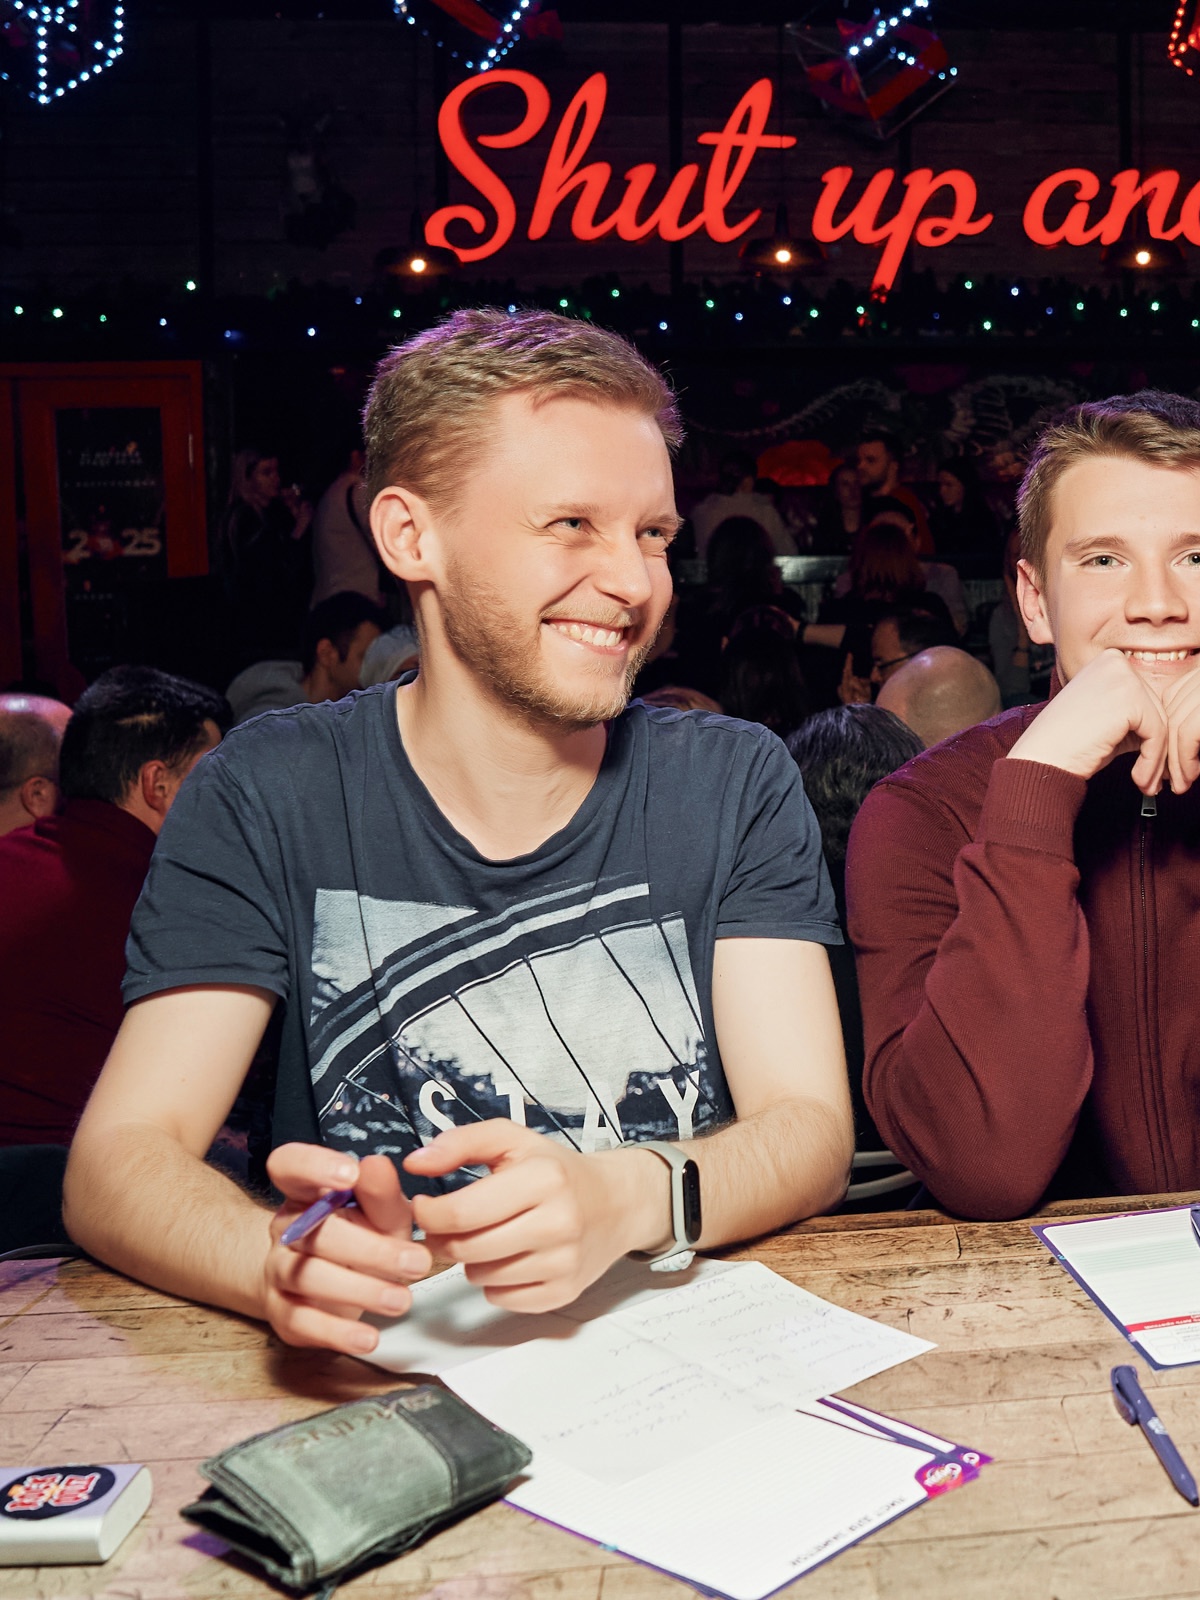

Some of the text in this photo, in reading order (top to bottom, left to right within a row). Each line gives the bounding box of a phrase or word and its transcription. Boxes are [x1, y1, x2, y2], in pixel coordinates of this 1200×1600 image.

[424, 69, 797, 264] Shut
[811, 165, 993, 292] up
[417, 1069, 700, 1153] STAY
